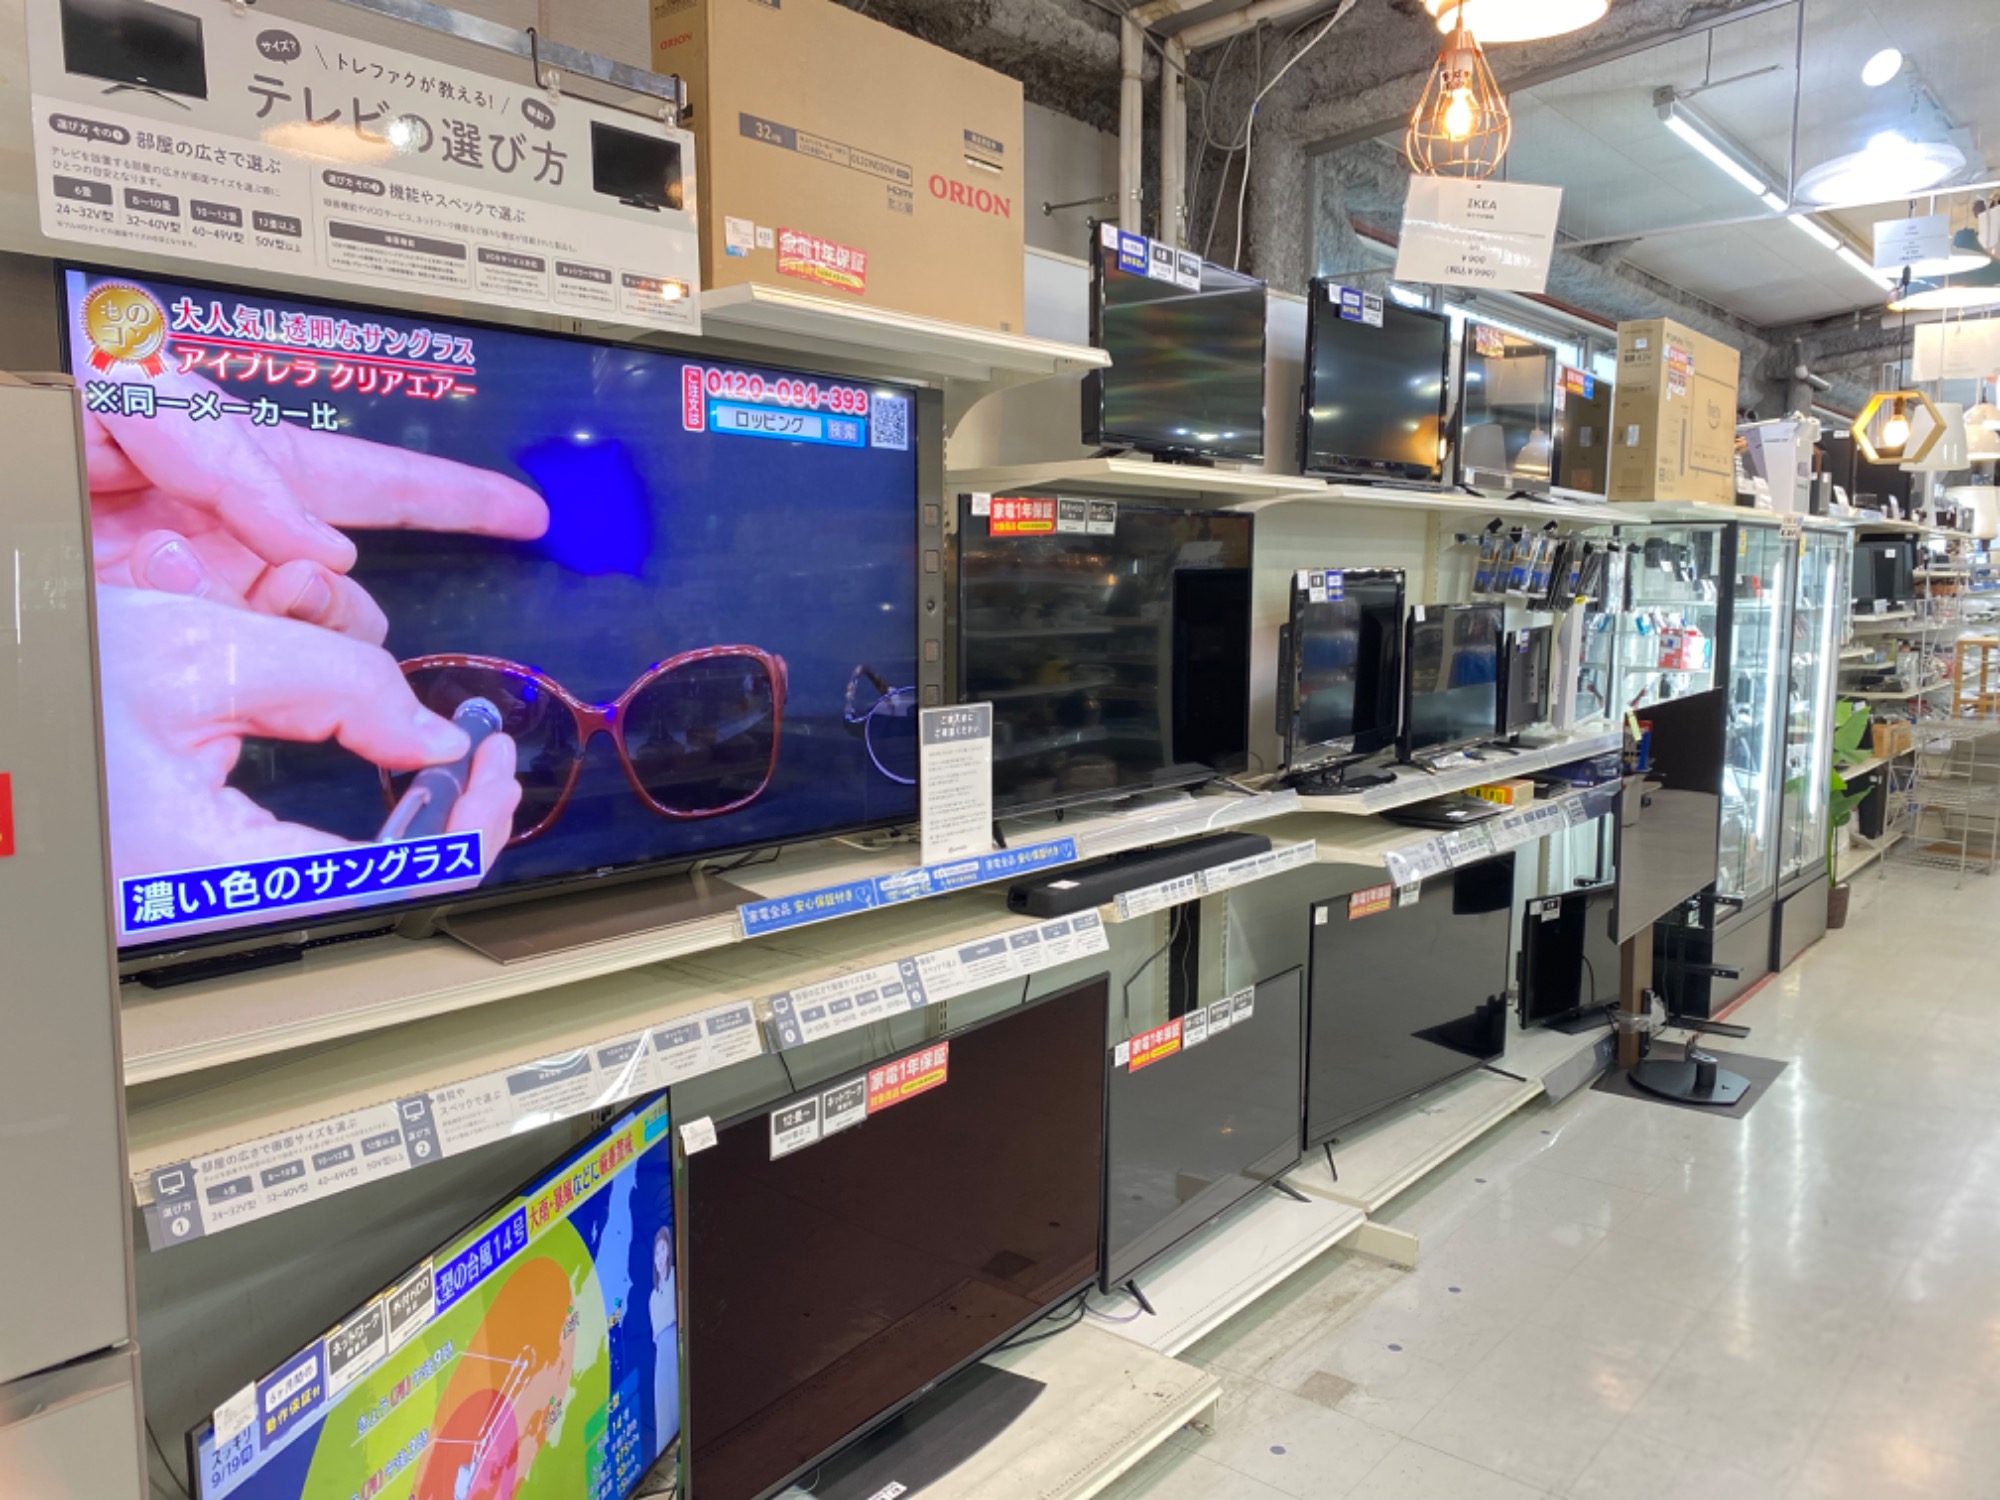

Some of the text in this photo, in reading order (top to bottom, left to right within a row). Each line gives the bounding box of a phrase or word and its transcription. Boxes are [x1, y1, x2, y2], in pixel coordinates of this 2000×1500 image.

[660, 31, 693, 50] ORION
[135, 131, 282, 174] 部屋の広さで選ぶ
[389, 183, 526, 223] 機能やスペックで選ぶ
[929, 174, 1011, 218] ORION
[1467, 198, 1497, 210] IKEA
[85, 381, 339, 431] ※同一メーカー比
[706, 368, 867, 413] 0120-084-393
[735, 410, 804, 433] ロッピング
[131, 840, 475, 923] 濃い色のサングラス
[871, 1046, 946, 1093] 家電1年保証
[435, 1214, 525, 1307] 型の台風14号
